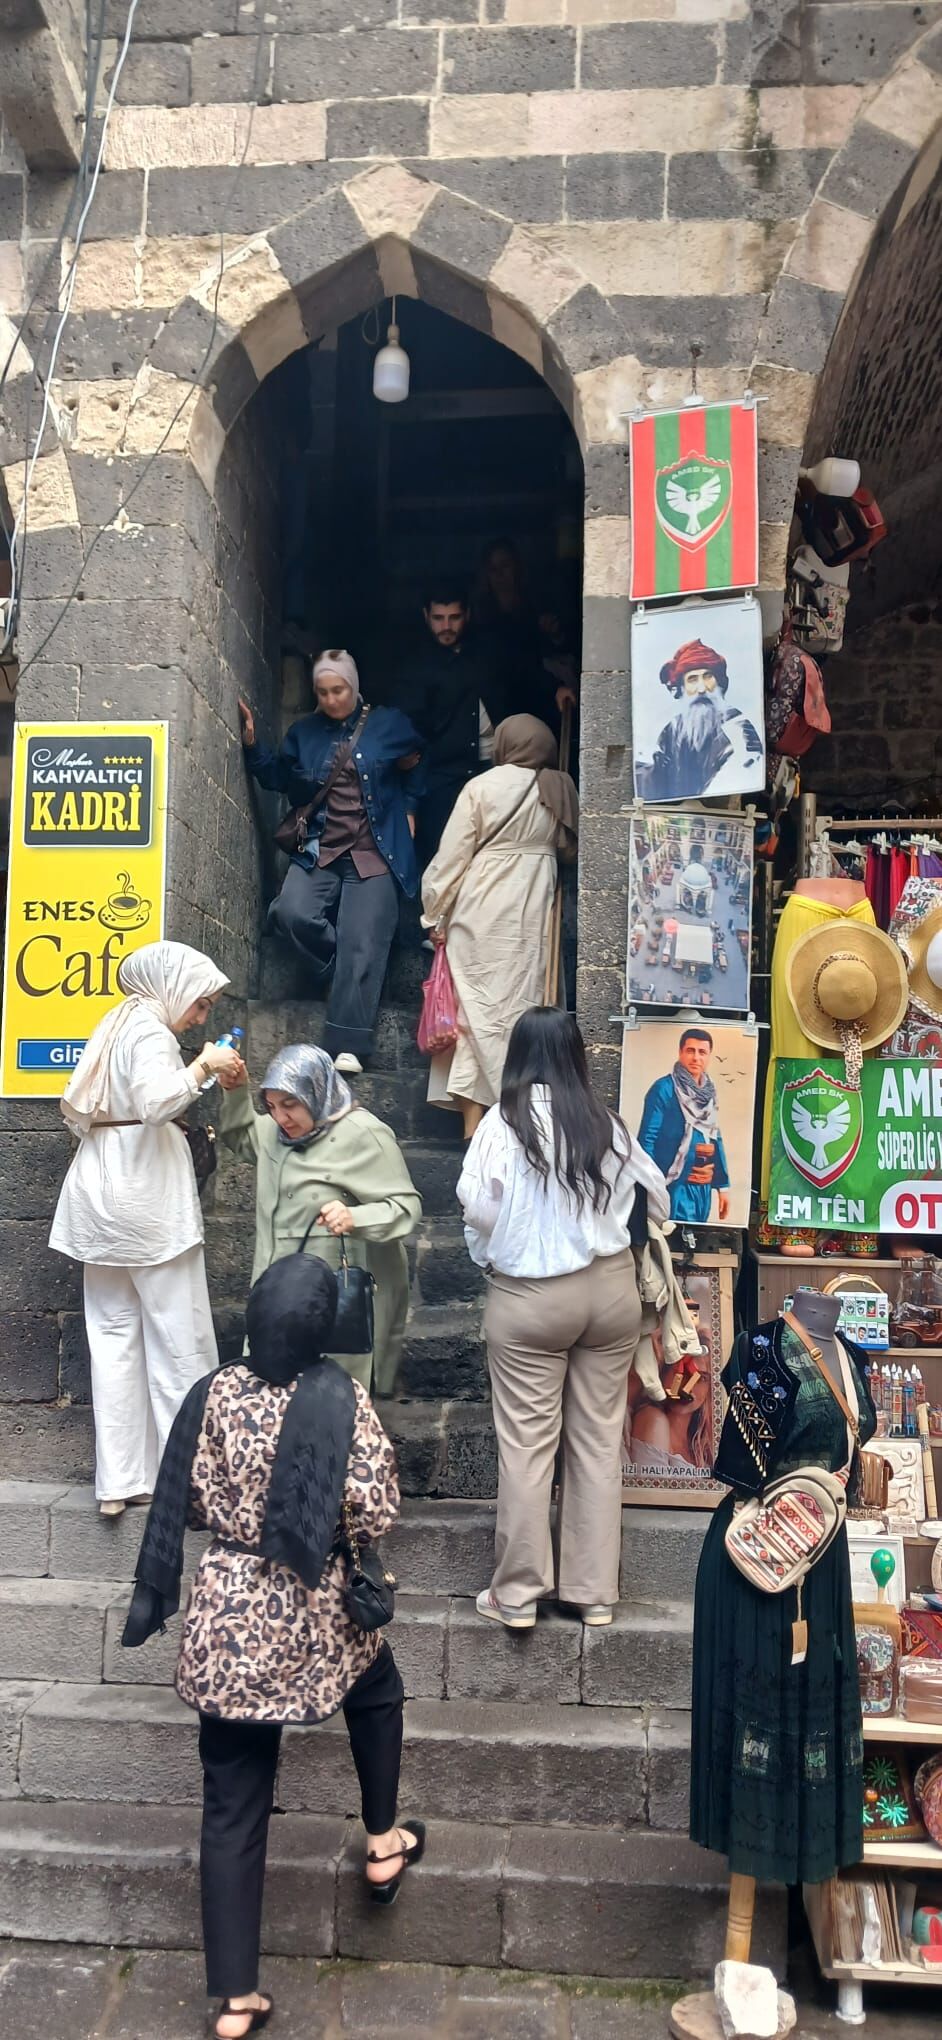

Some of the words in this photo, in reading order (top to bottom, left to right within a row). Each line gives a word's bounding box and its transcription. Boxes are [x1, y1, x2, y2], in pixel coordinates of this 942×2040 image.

[32, 769, 143, 784] KAHVALTICI
[30, 783, 142, 832] KADRİ
[23, 900, 97, 922] ENES
[796, 1087, 827, 1100] AMED
[877, 1122, 915, 1171] SÜPER
[917, 1123, 936, 1170] LİG
[777, 1194, 812, 1220] EM
[817, 1193, 865, 1224] TÊN
[641, 1466, 664, 1475] HALI
[666, 1467, 711, 1477] YAPALIM
